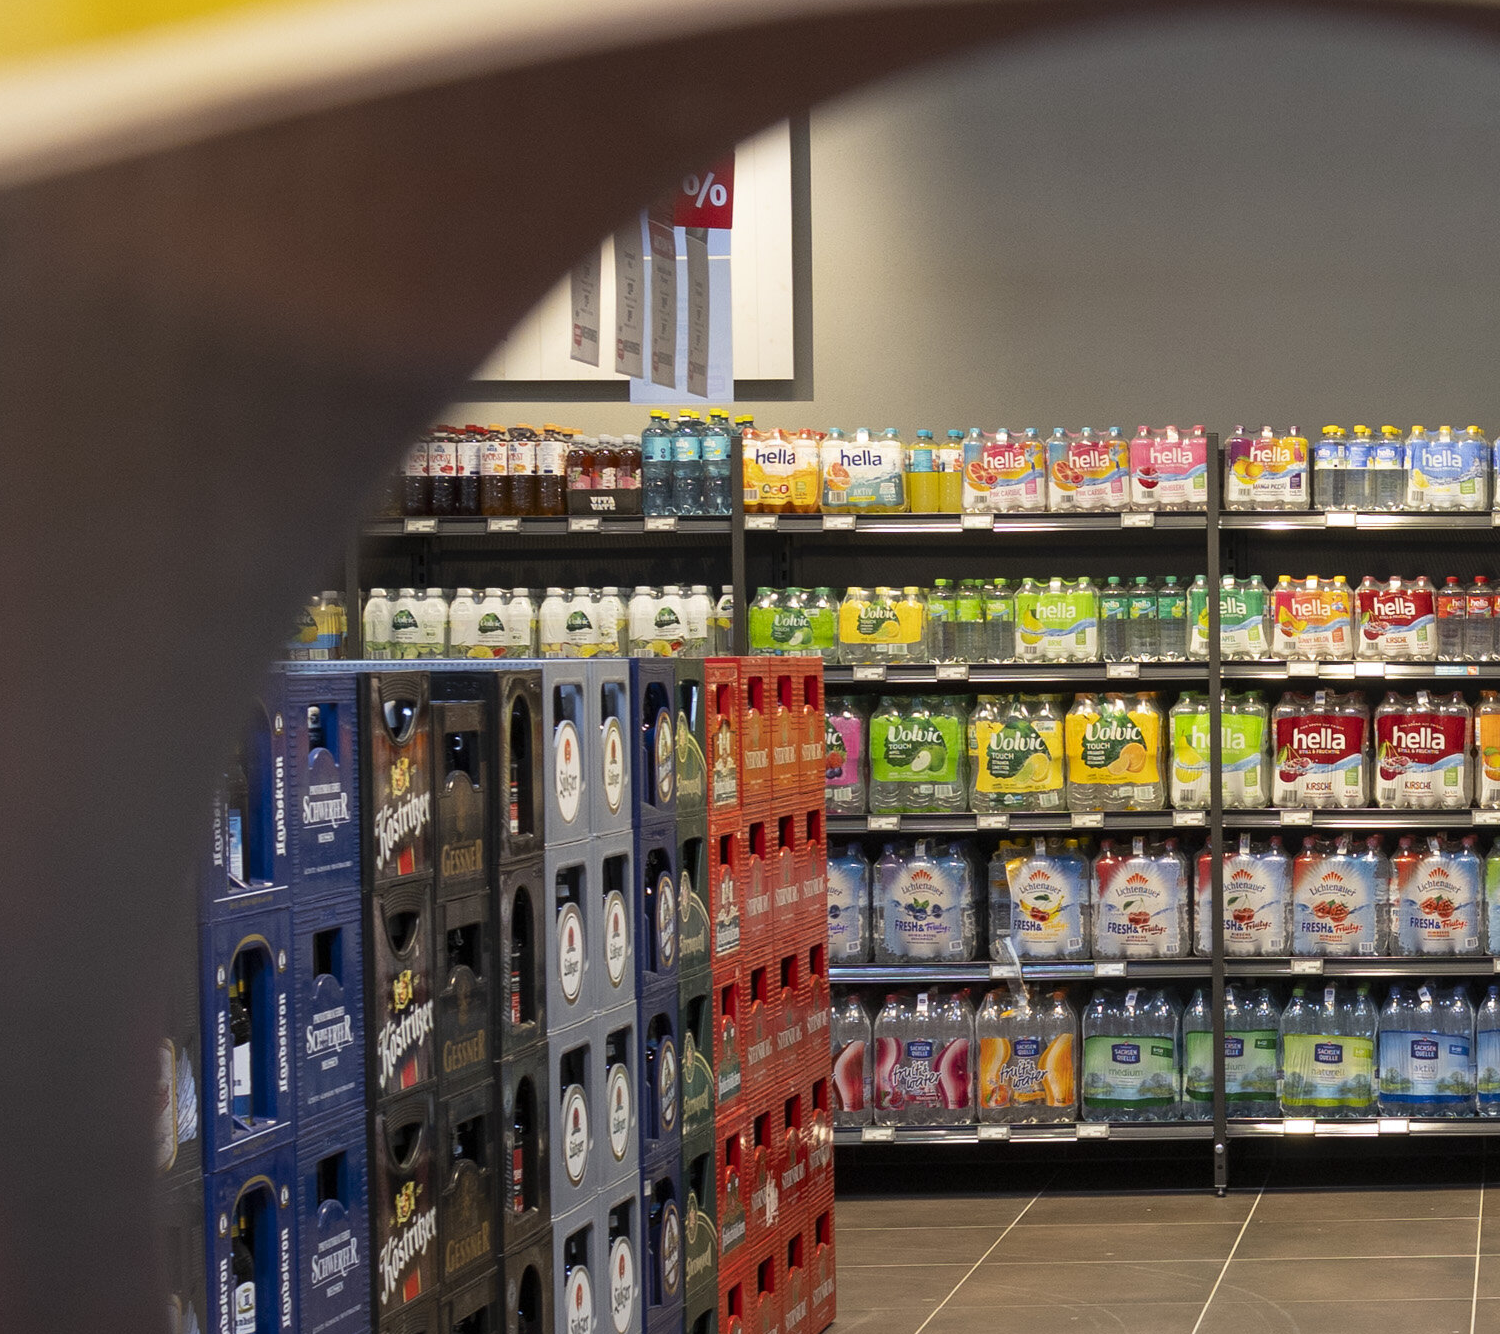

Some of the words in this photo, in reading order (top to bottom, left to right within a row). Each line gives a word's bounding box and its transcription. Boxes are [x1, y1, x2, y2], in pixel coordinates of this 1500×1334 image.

[756, 449, 795, 464] hella
[841, 450, 882, 466] hella
[983, 451, 1025, 469] hella
[1069, 451, 1110, 468] hella
[1150, 447, 1192, 464] hella
[1250, 446, 1290, 462] hella
[1422, 449, 1462, 467] hella
[590, 496, 615, 504] VITA
[1036, 602, 1076, 618] hella
[1206, 596, 1247, 614] ella
[1291, 599, 1331, 616] hella
[1373, 597, 1415, 615] hella
[1470, 599, 1489, 607] hella
[774, 615, 810, 626] Volvic
[860, 607, 897, 619] Volvic
[888, 725, 942, 743] Volvic
[1086, 722, 1141, 741] Volvic
[1293, 728, 1345, 750] hella
[1392, 726, 1446, 750] hella
[990, 731, 1045, 751] Volvic
[1086, 742, 1110, 750] TOUCH
[991, 752, 1014, 760] TOUCH
[1306, 782, 1332, 791] KIRSCHE
[1405, 781, 1431, 790] KIRSCHE
[275, 755, 287, 857] Landskron
[374, 790, 431, 871] Köstritzer
[441, 838, 483, 878] GESSNER
[901, 882, 944, 897] Lichtenauer
[1019, 882, 1062, 895] Lichtenauer
[1115, 883, 1161, 899] Lichtenauer
[1223, 881, 1265, 893] ichtenauer
[1309, 883, 1356, 897] Lichtenauer
[1417, 881, 1461, 894] Lichtenauer
[1223, 920, 1244, 931] ESH&
[278, 992, 289, 1093] Landskron
[378, 998, 434, 1090] Köstritzer
[1414, 1044, 1436, 1052] SACHSEN
[443, 1028, 486, 1074] GESSNER
[1114, 1048, 1138, 1056] SACHSEN
[1317, 1048, 1341, 1056] SACHSEN
[217, 1010, 227, 1116] Landskron
[1311, 1066, 1345, 1076] naturell
[1414, 1063, 1436, 1072] aktiv
[893, 1064, 922, 1085] fruit
[1109, 1067, 1143, 1077] medium
[906, 1072, 941, 1090] water
[445, 1220, 490, 1273] GESSNER
[379, 1206, 437, 1305] Köstritzer
